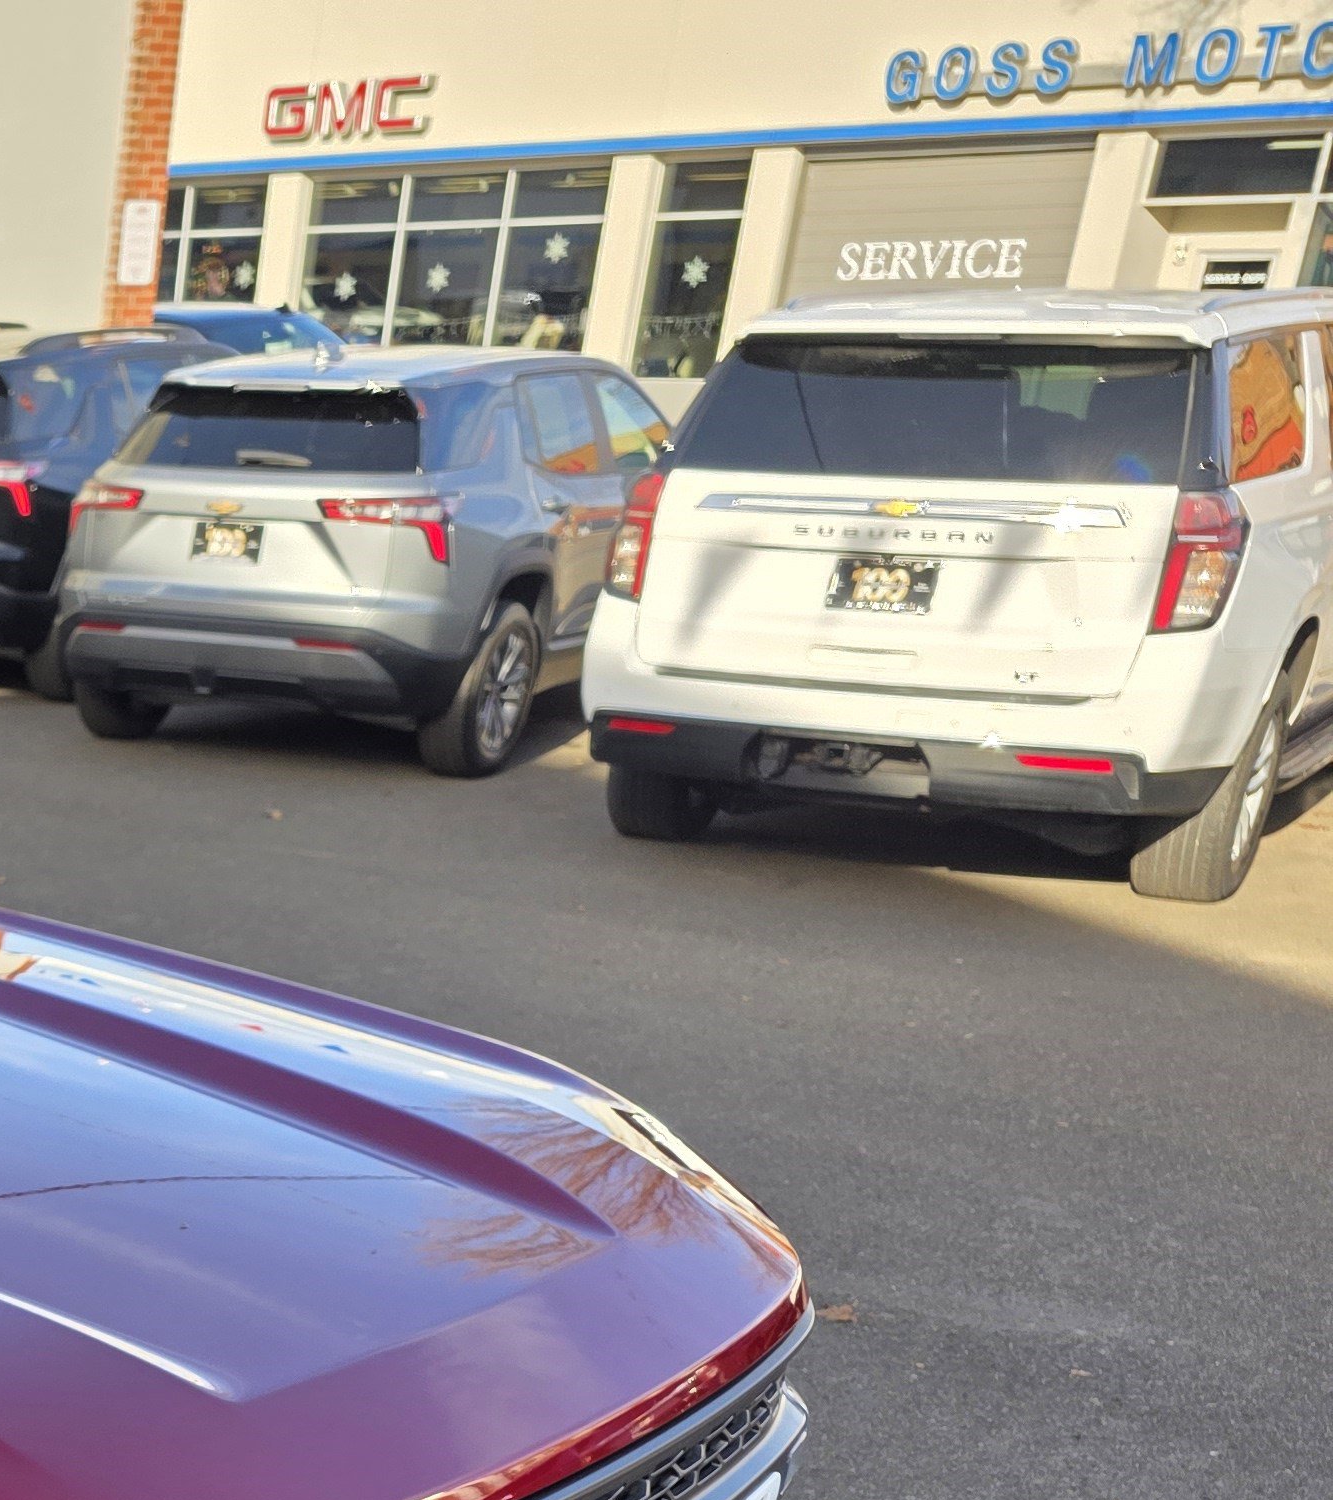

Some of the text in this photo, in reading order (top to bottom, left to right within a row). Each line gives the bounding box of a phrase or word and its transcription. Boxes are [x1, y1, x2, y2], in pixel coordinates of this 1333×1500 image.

[884, 37, 1078, 105] GOSS
[263, 74, 432, 138] GMC
[837, 239, 1027, 281] SERVICE
[793, 524, 995, 544] SUBURBAN
